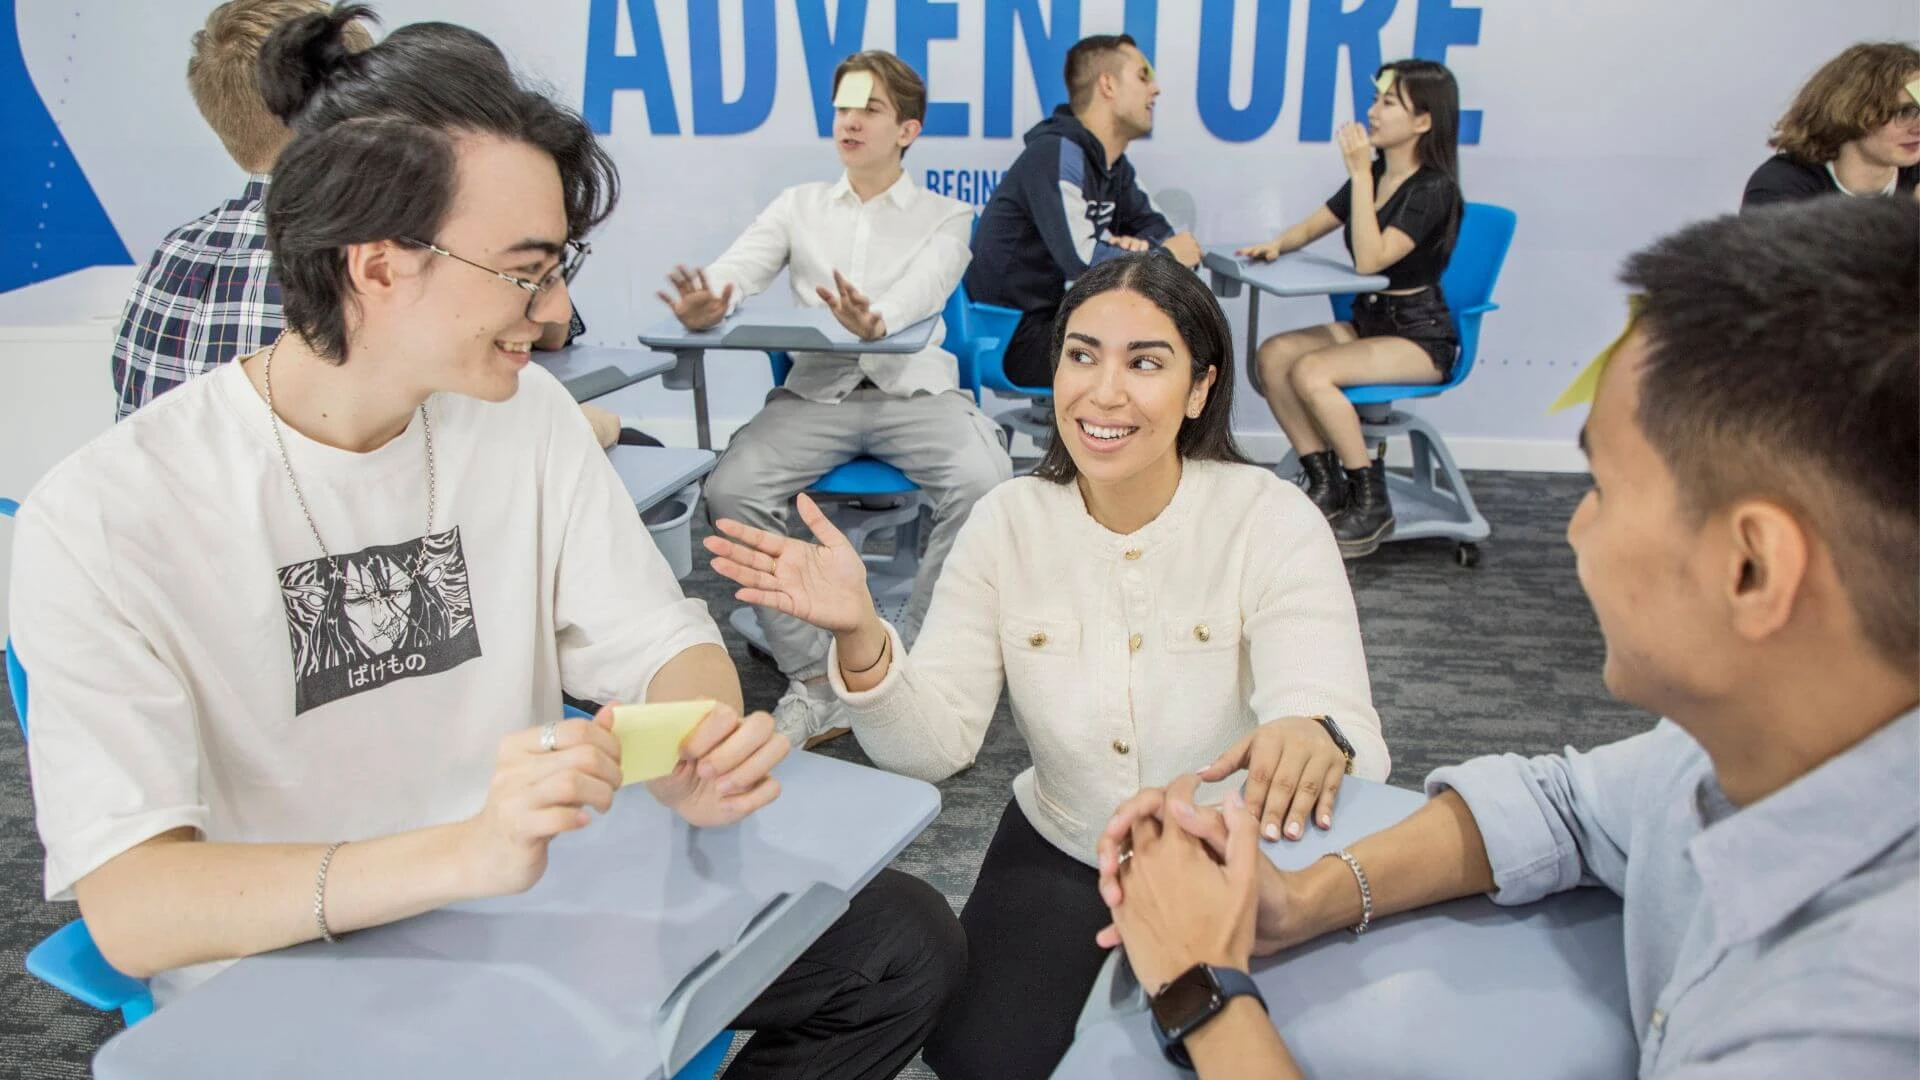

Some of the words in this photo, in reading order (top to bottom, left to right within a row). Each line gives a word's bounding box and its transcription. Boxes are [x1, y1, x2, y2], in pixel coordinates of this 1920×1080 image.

[583, 0, 1483, 145] ADVENUR
[926, 170, 1008, 206] BEGIN
[348, 653, 426, 688] ばけもの
